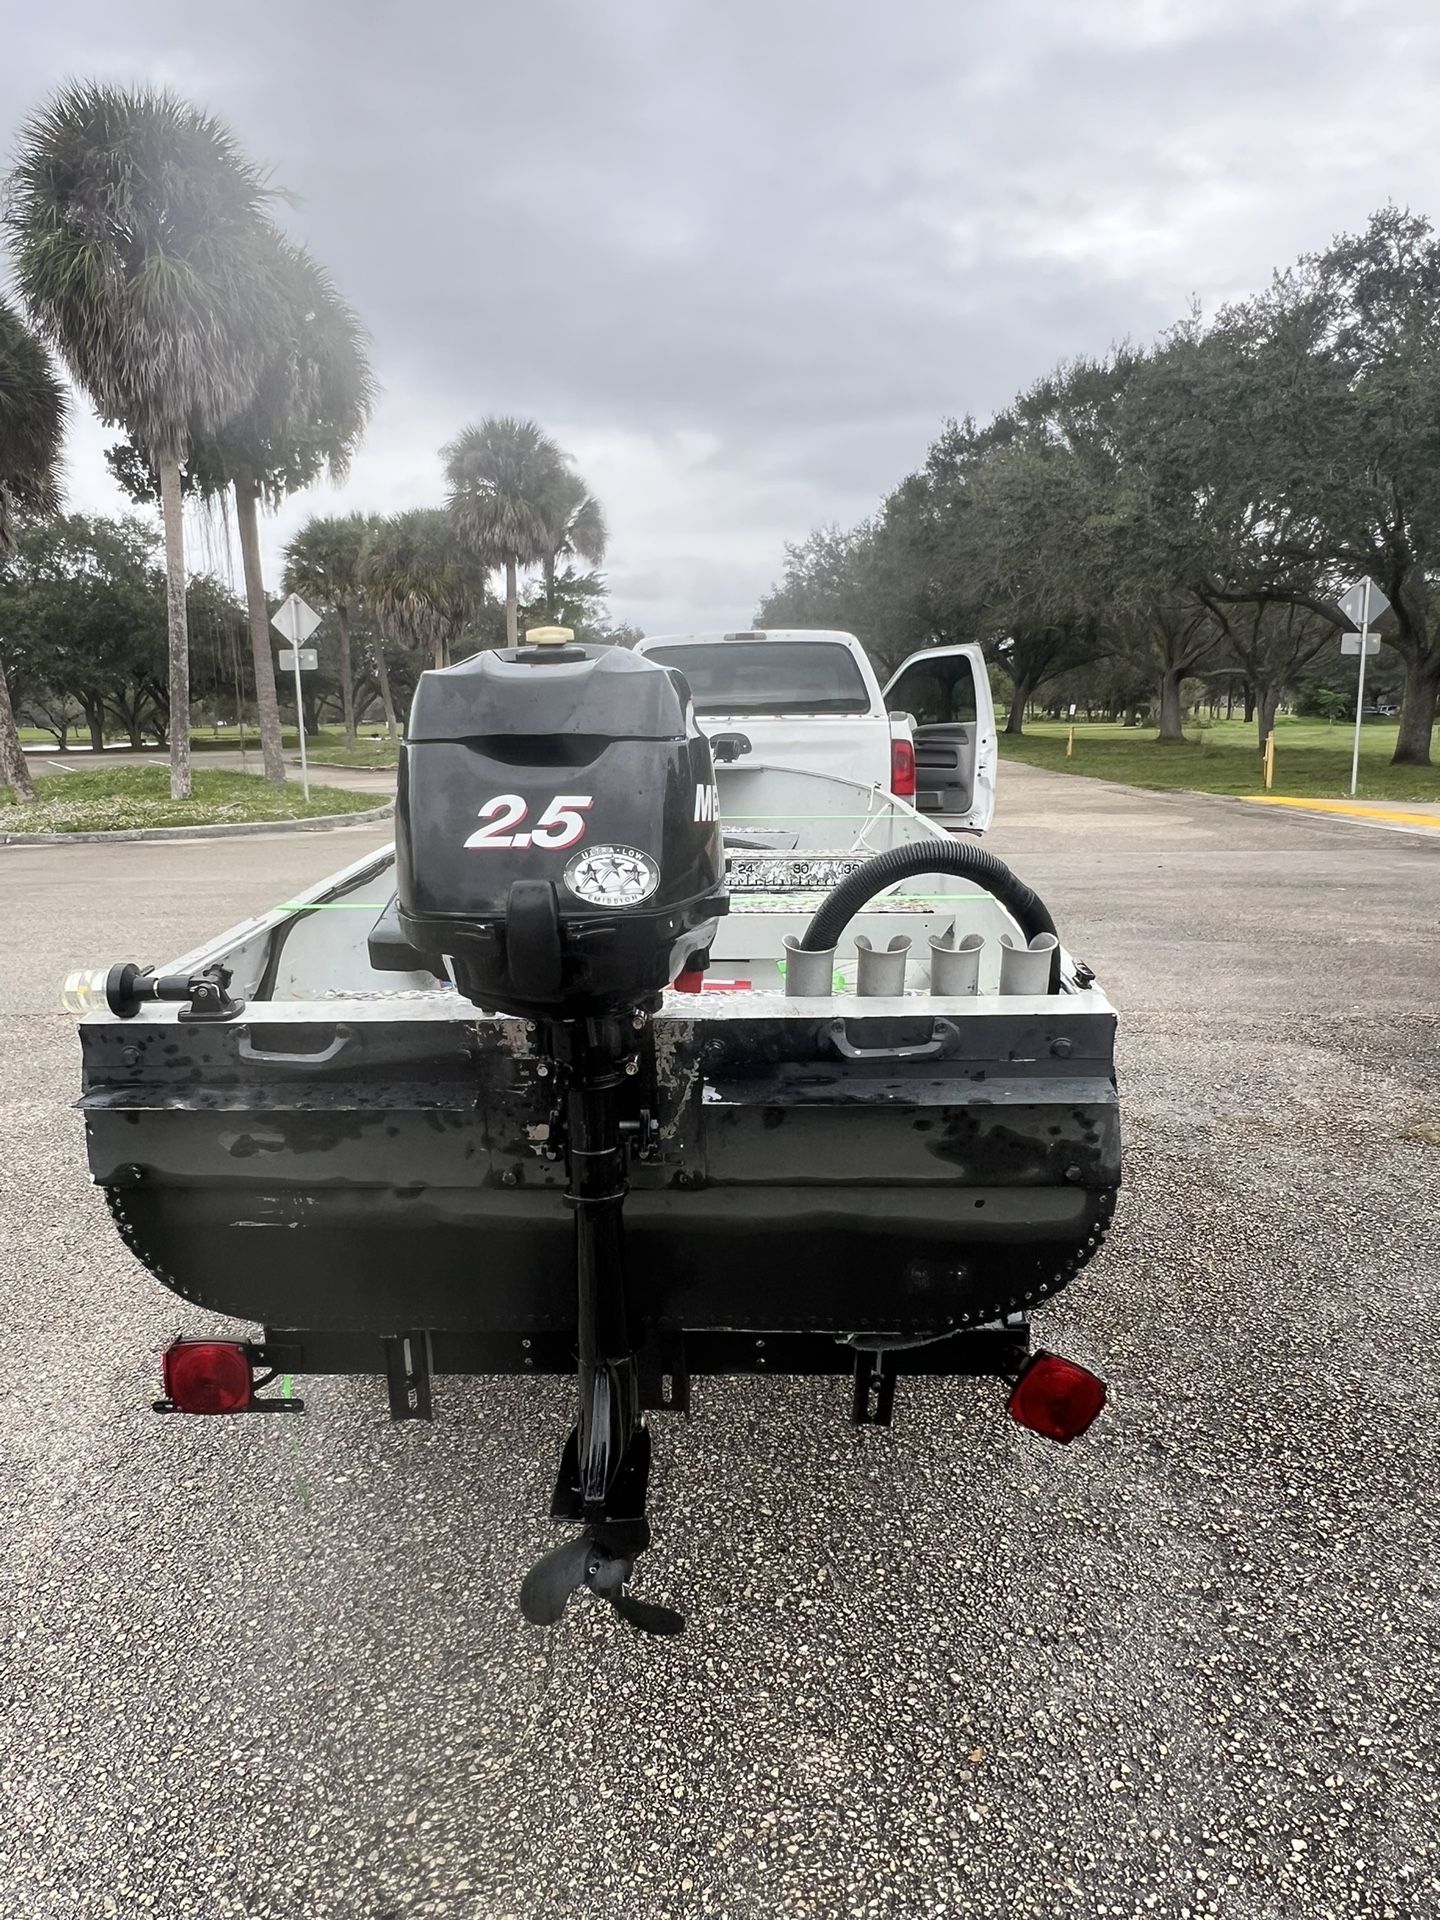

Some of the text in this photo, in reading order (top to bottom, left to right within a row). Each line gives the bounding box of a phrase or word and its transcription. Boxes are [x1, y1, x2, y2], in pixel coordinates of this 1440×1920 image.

[463, 794, 594, 850] 2.5
[581, 846, 645, 861] ULTRA LOW
[737, 863, 755, 875] 24
[792, 863, 809, 875] 30
[587, 894, 638, 905] EMISSION
